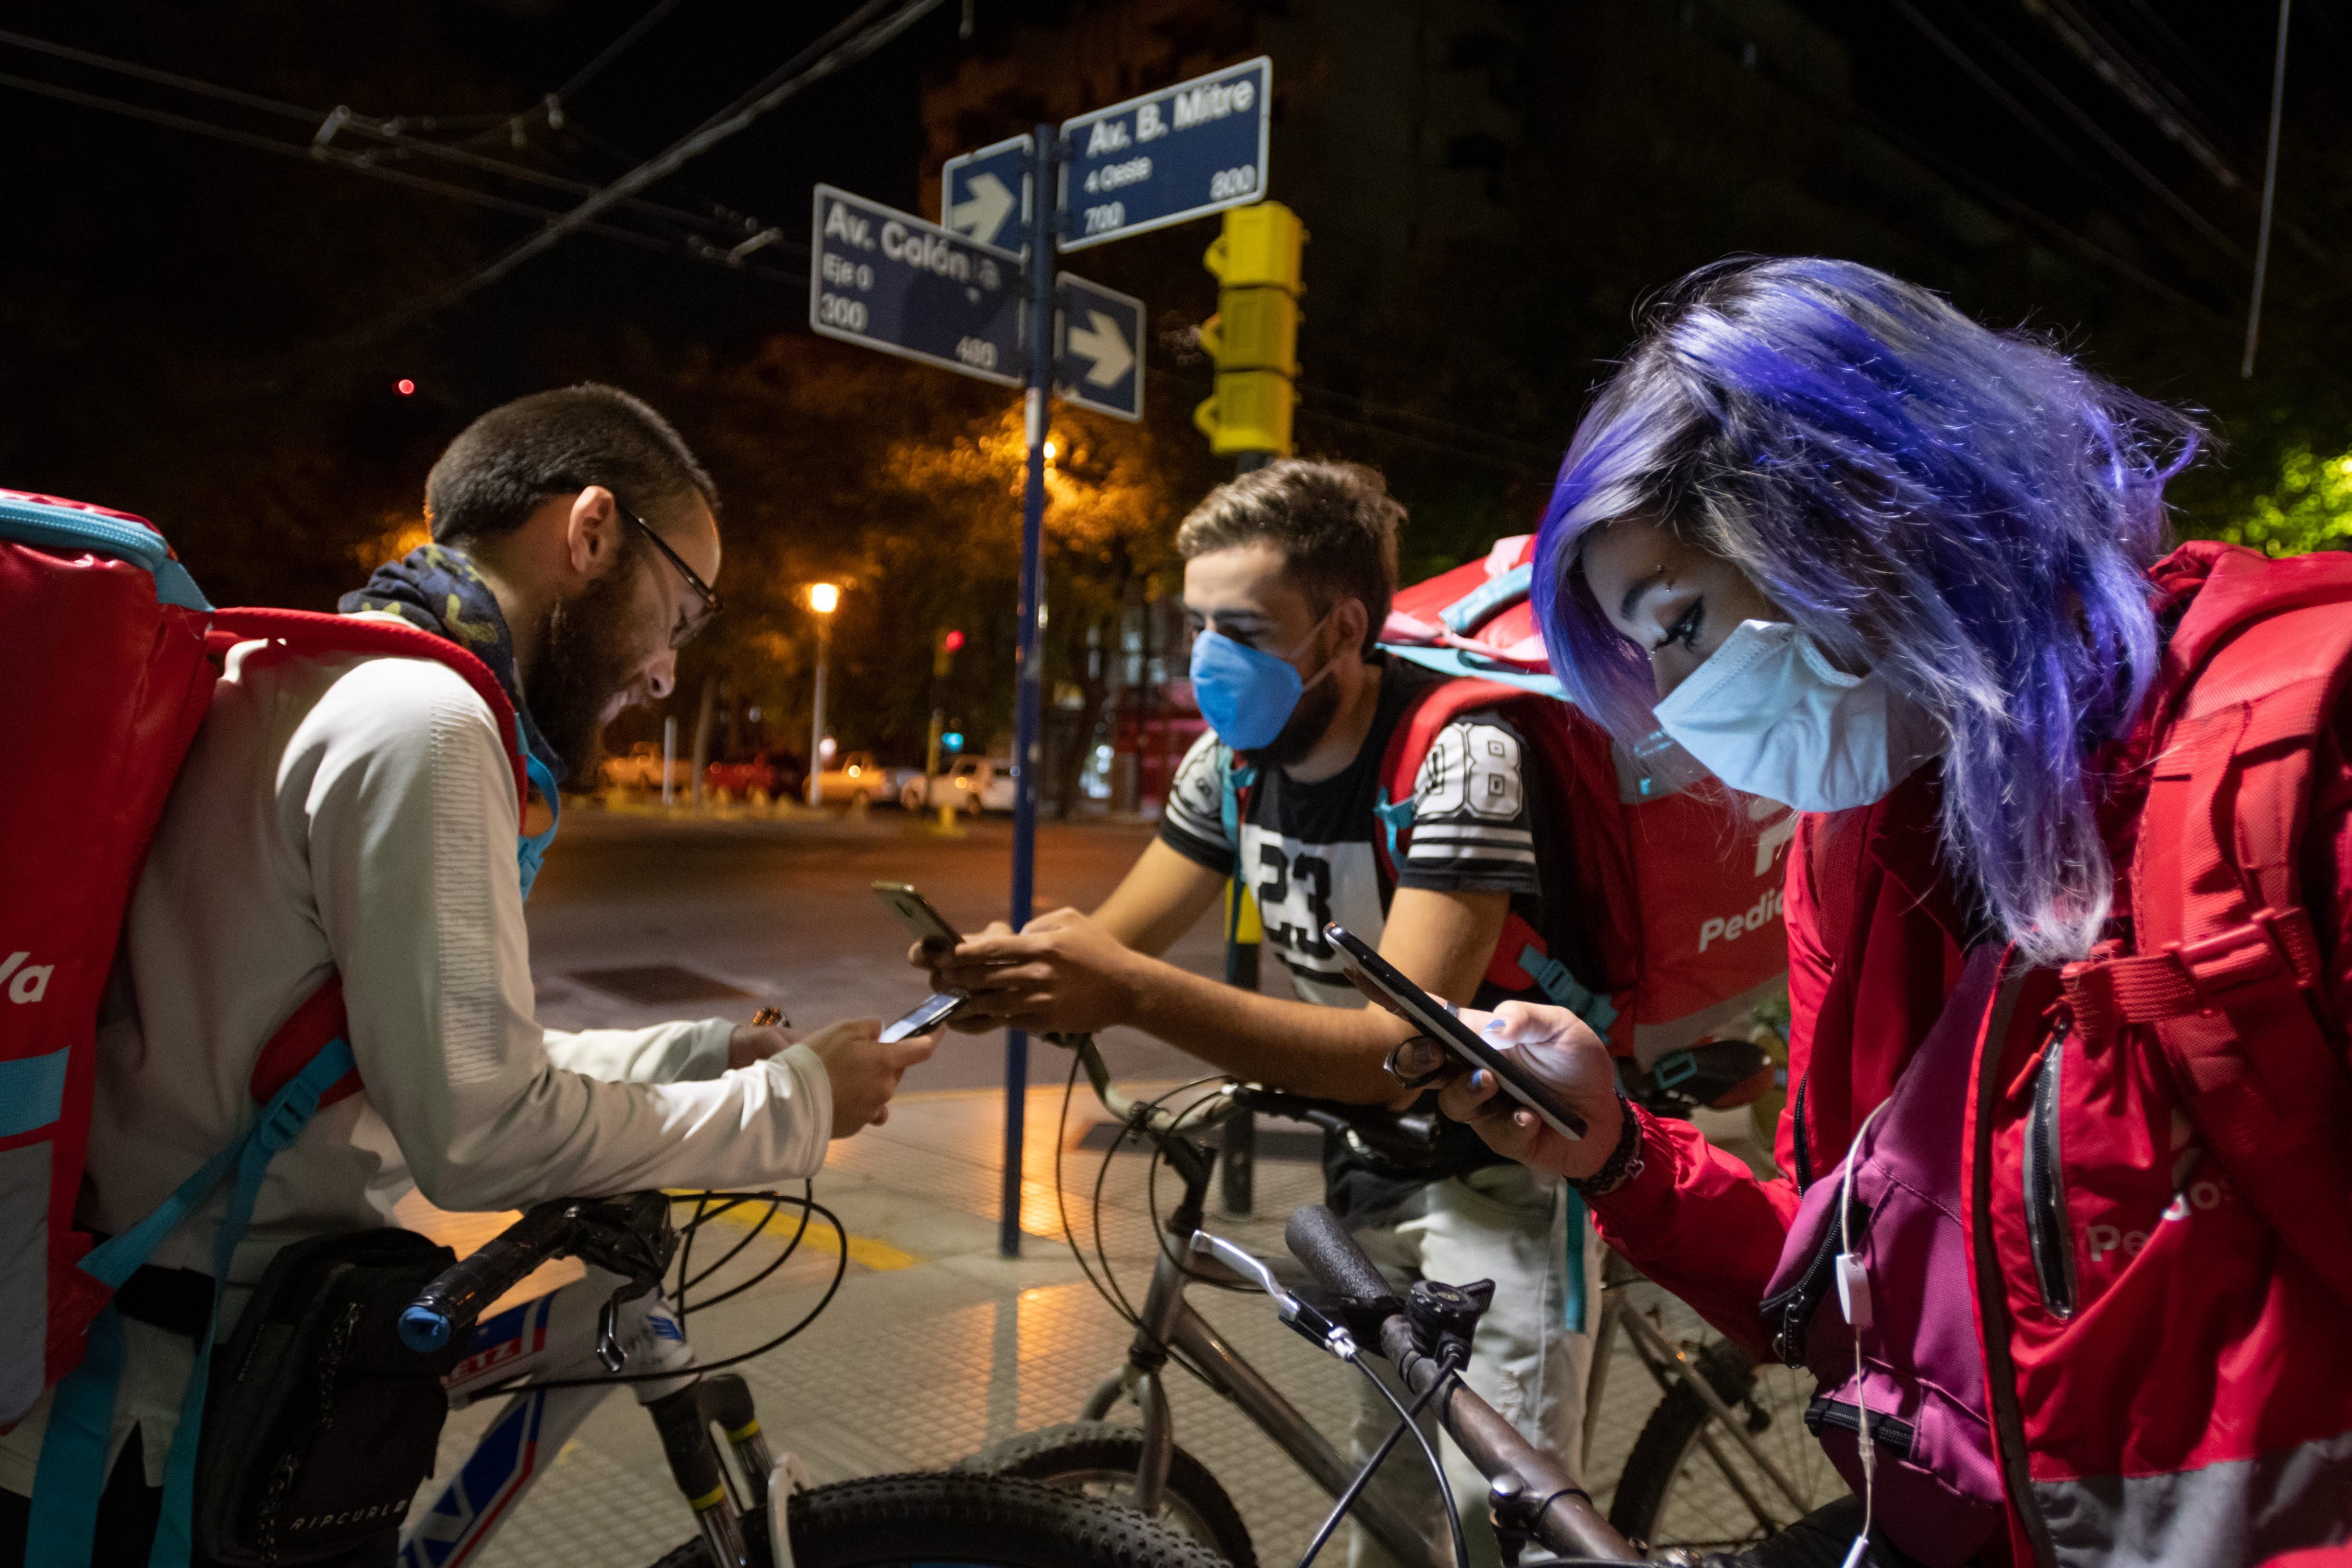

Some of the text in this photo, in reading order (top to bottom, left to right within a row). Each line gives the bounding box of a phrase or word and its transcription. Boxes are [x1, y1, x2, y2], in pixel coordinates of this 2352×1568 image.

[1085, 80, 1255, 159] Av. B. Mitre
[824, 201, 876, 251] Av.
[1083, 201, 1126, 236] 700
[821, 292, 868, 333] 300
[1259, 843, 1337, 960] 23
